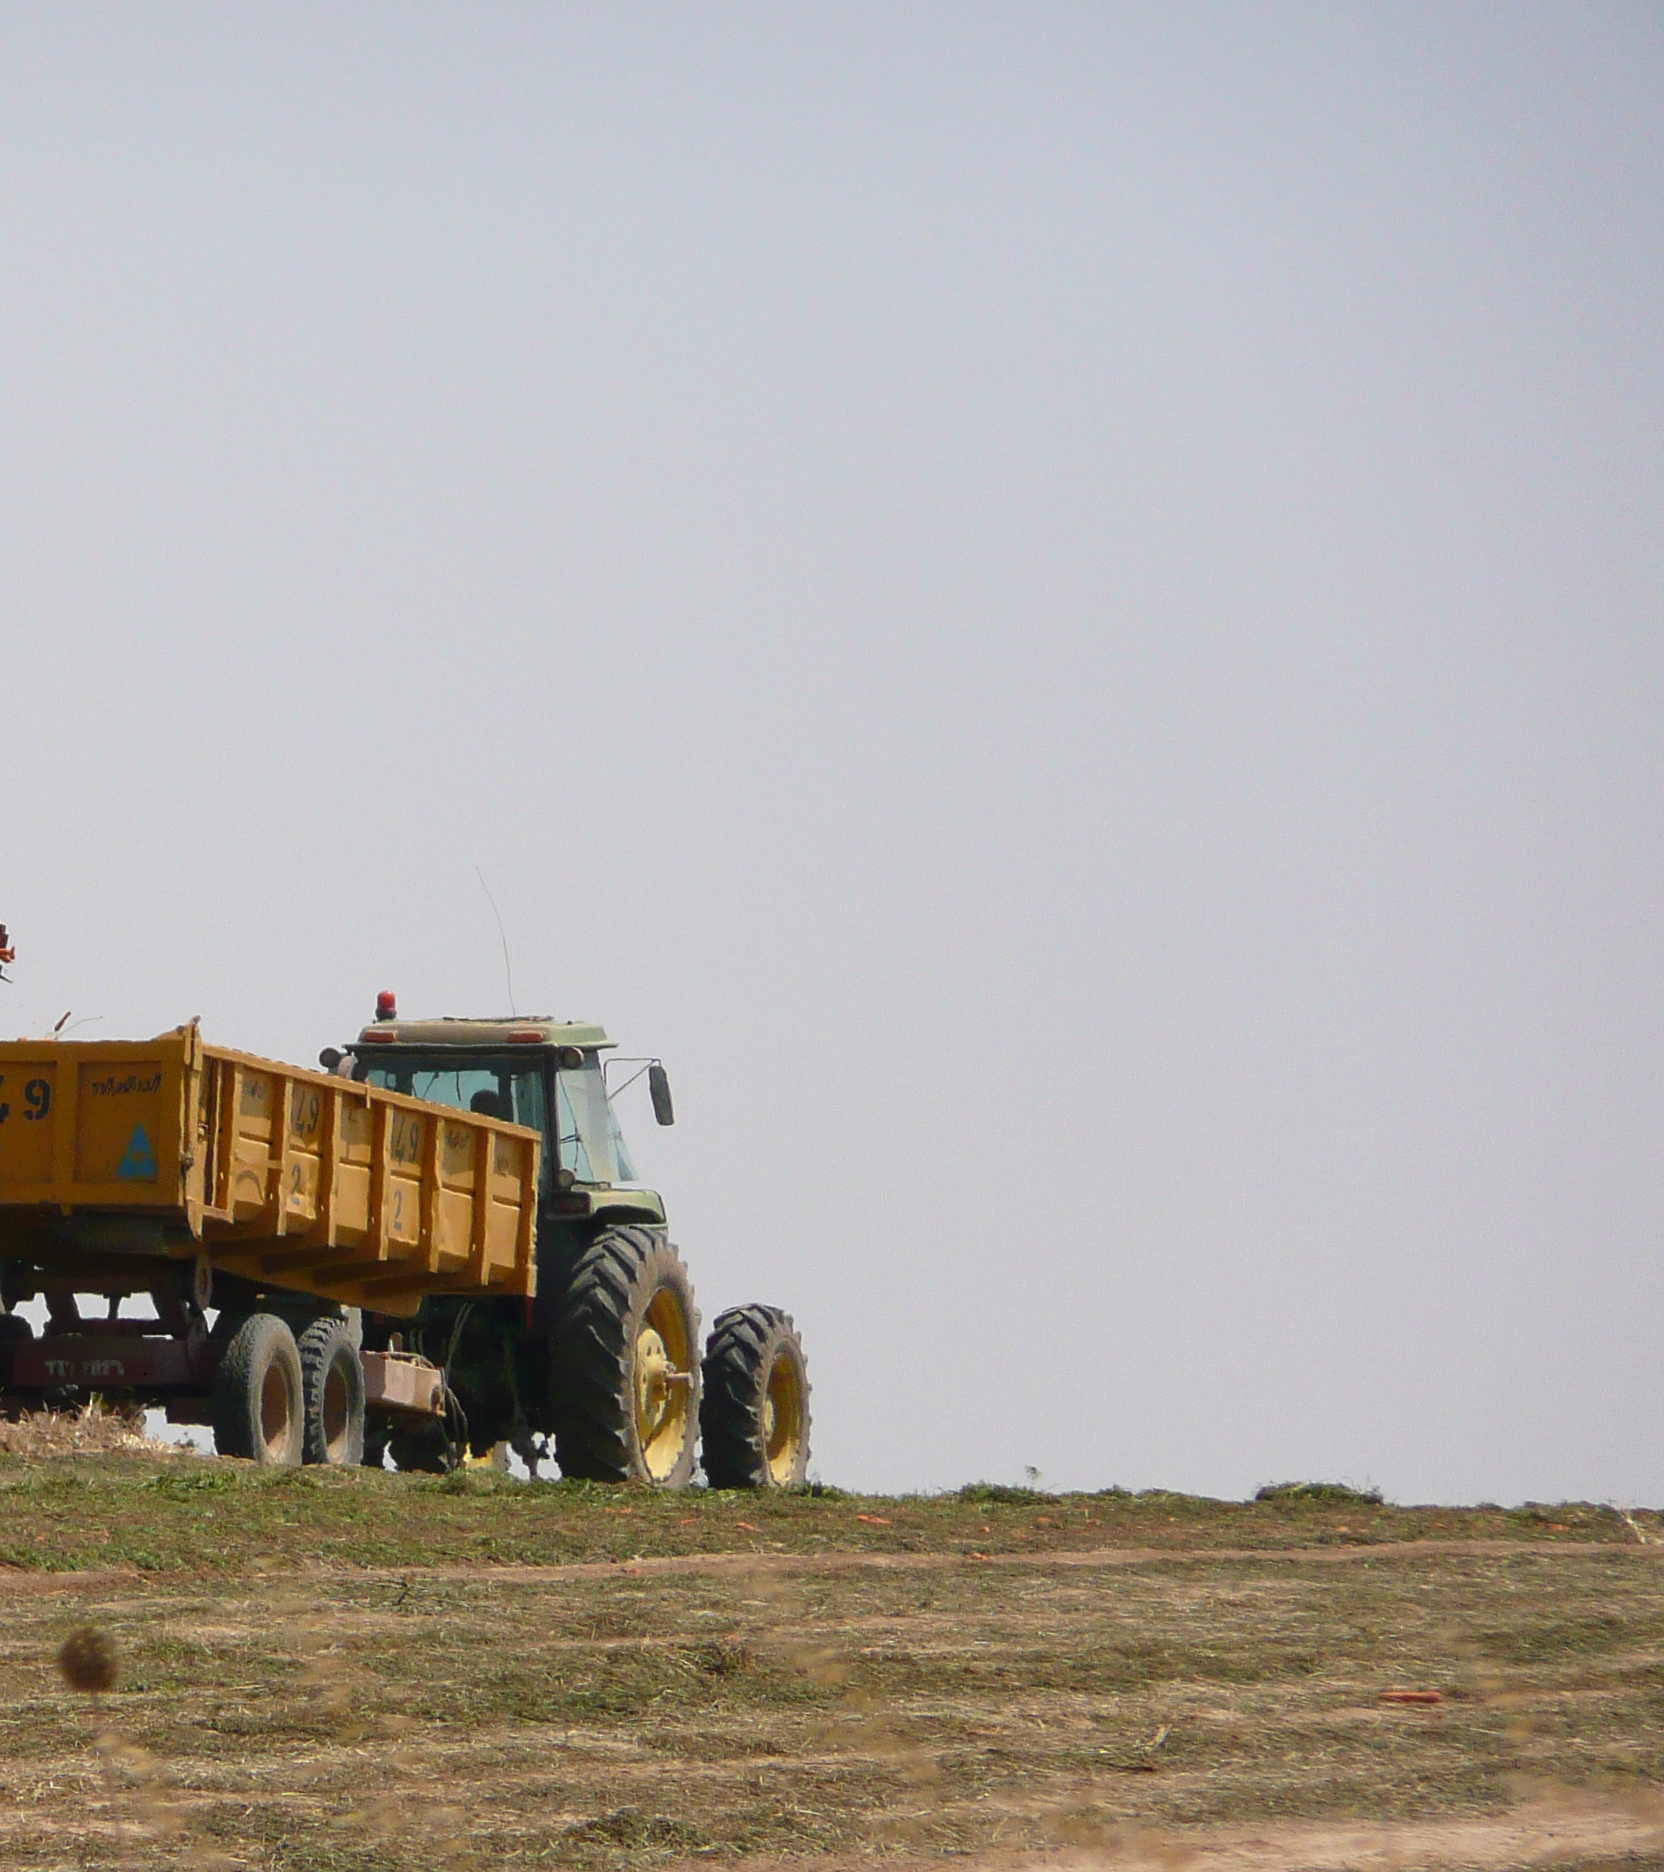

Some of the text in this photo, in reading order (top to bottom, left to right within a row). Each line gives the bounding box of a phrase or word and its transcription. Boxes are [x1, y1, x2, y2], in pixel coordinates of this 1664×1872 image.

[290, 1085, 318, 1137] 49
[391, 1112, 419, 1166] 49
[291, 1164, 302, 1206] 2
[393, 1188, 403, 1230] 2
